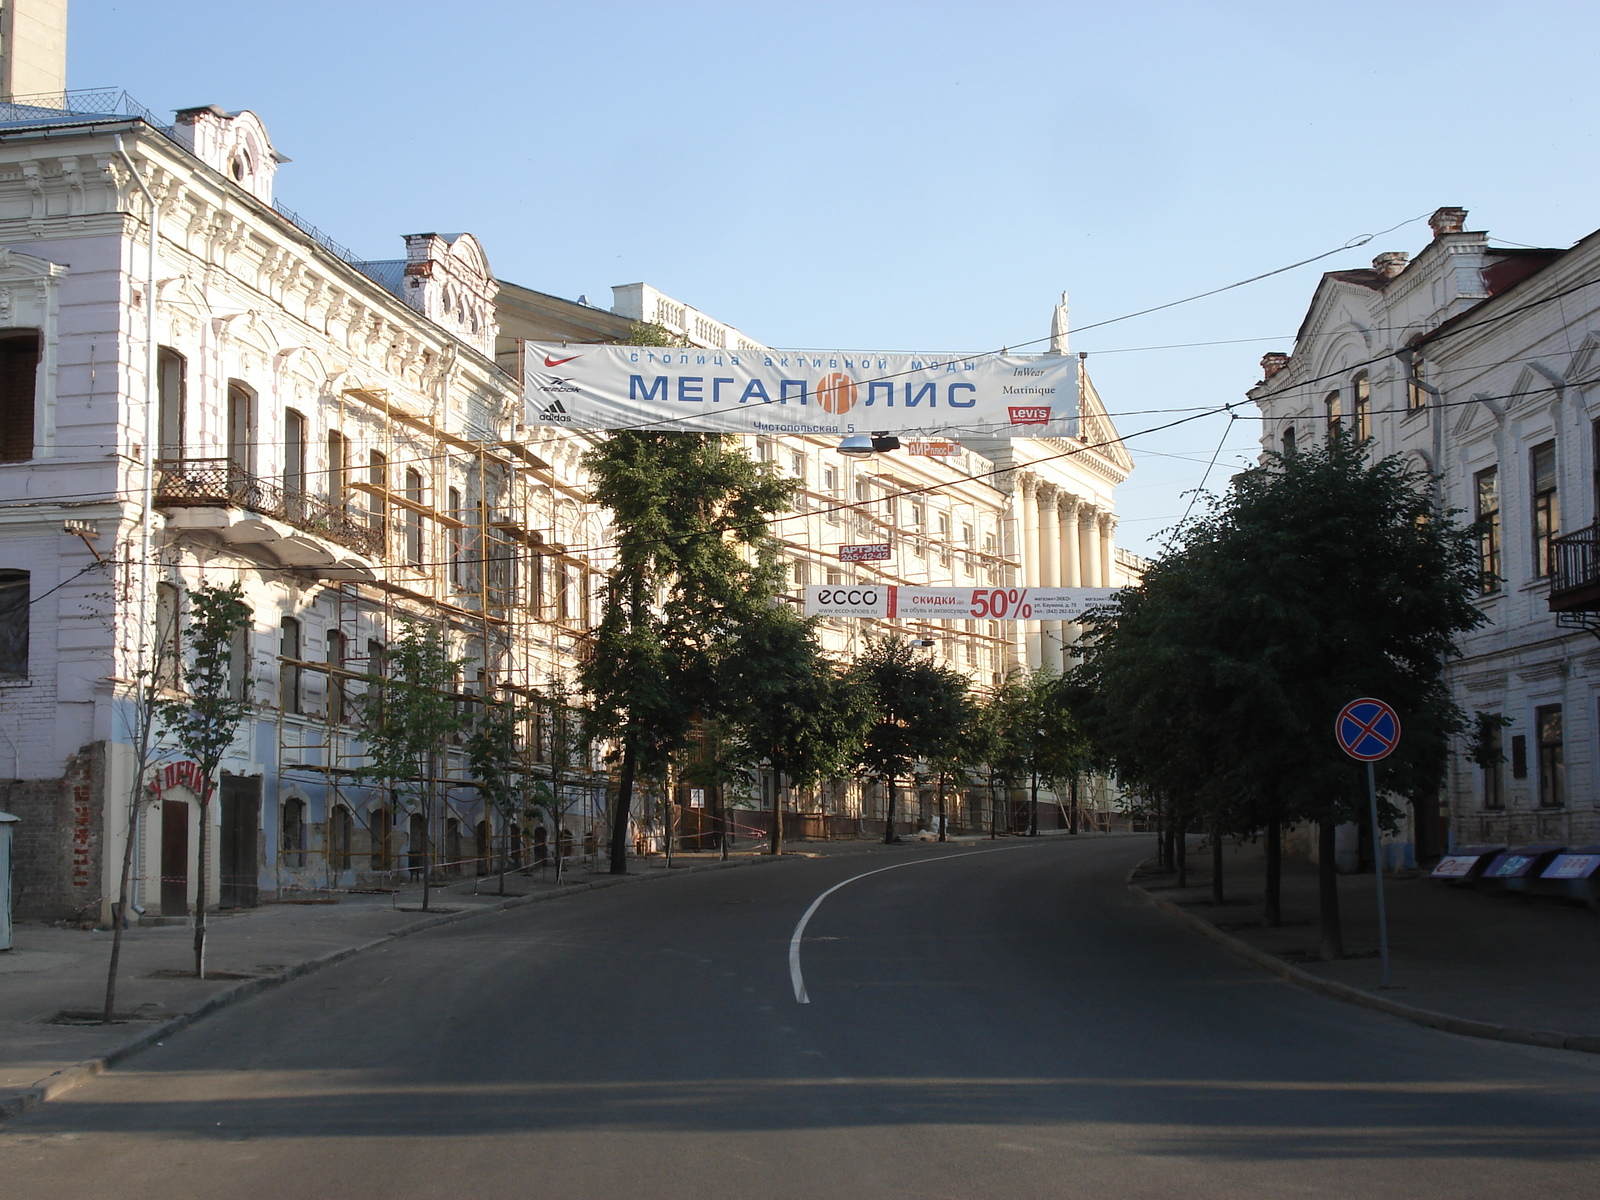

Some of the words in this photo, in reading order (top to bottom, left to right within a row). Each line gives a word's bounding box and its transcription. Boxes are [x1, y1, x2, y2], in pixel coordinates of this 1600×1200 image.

[630, 352, 739, 367] столица
[764, 357, 887, 369] активной
[911, 360, 975, 372] моды
[1013, 366, 1045, 377] InWear
[1002, 385, 1056, 396] Matinique
[539, 413, 572, 422] adidas
[847, 423, 855, 433] 5
[841, 544, 889, 553] АРТЭКС
[818, 589, 877, 605] ecco
[912, 595, 956, 605] скидки
[970, 589, 1032, 618] 50%
[909, 606, 927, 614] обувь
